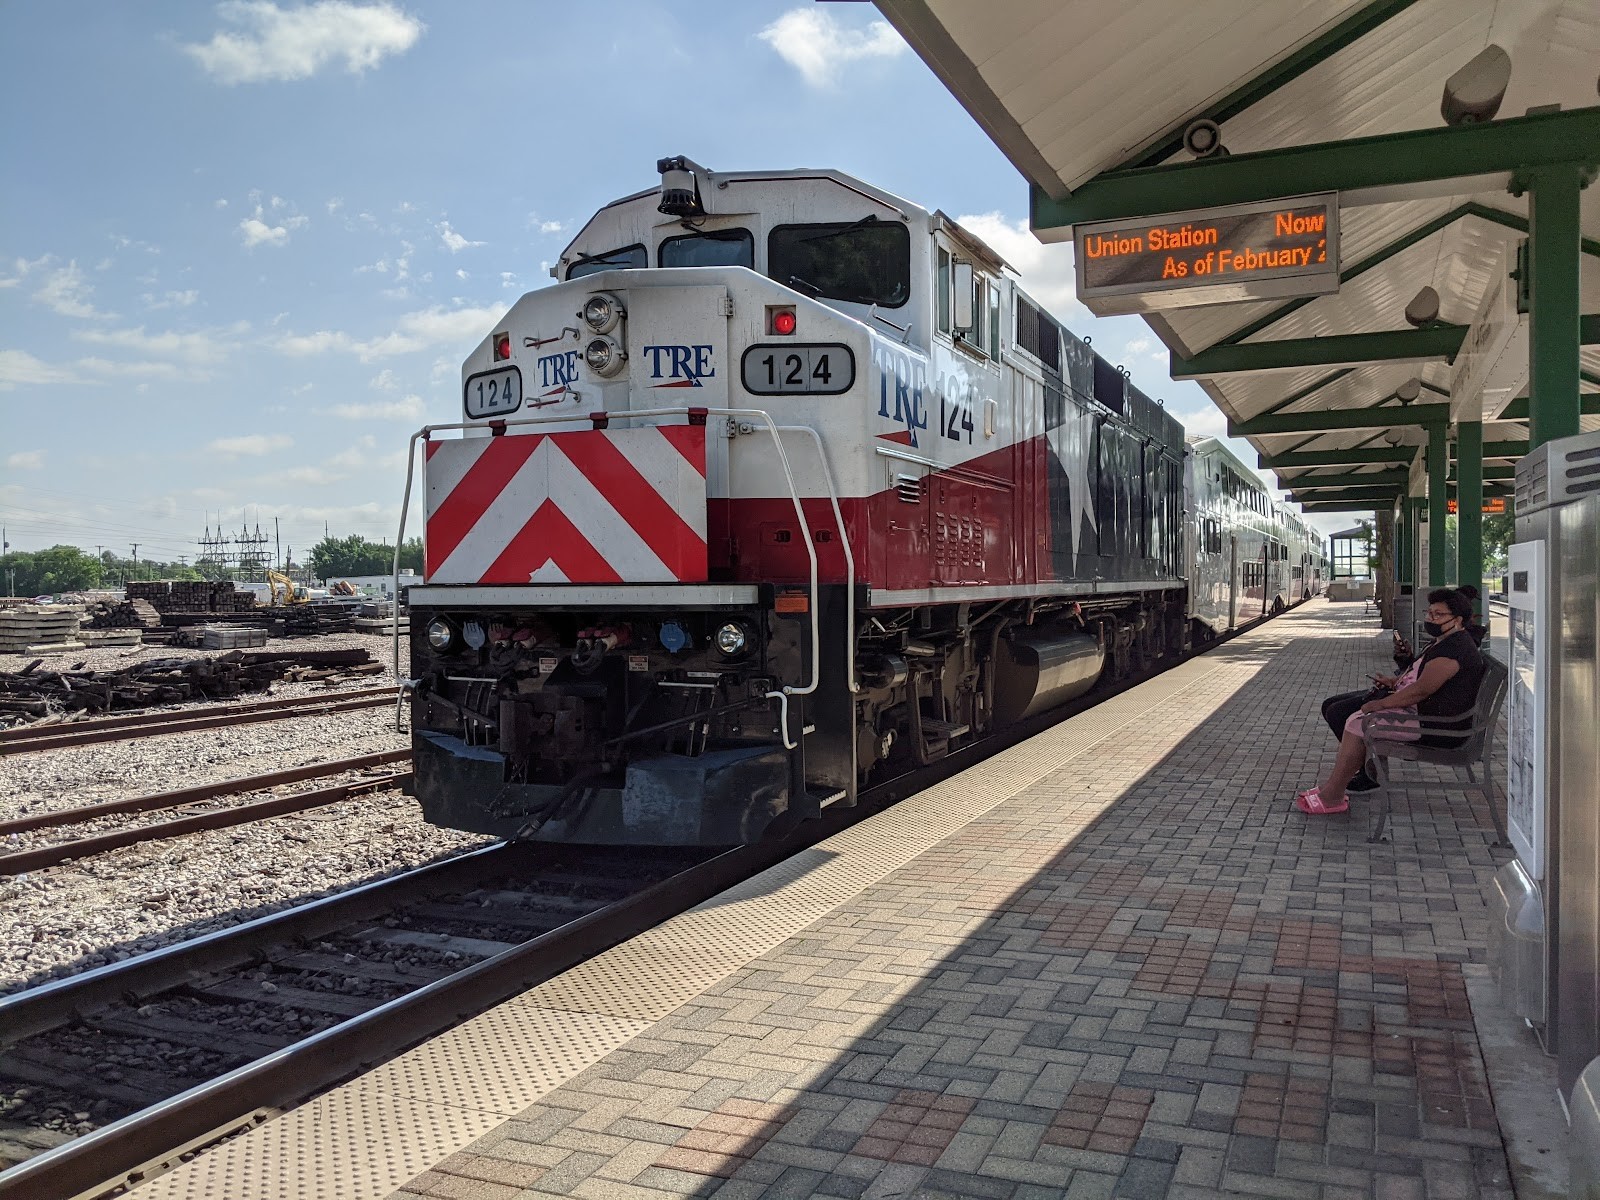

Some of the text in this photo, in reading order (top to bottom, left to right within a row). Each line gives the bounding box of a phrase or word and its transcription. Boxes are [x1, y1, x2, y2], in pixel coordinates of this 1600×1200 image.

[1087, 213, 1325, 258] Union Station Now
[1163, 257, 1188, 278] As
[1195, 252, 1214, 275] of
[1219, 247, 1312, 272] February
[537, 350, 579, 389] TRE
[643, 345, 715, 387] TRE
[762, 354, 832, 385] 124
[476, 377, 513, 409] 124
[873, 341, 927, 447] TRE
[936, 370, 974, 445] 124
